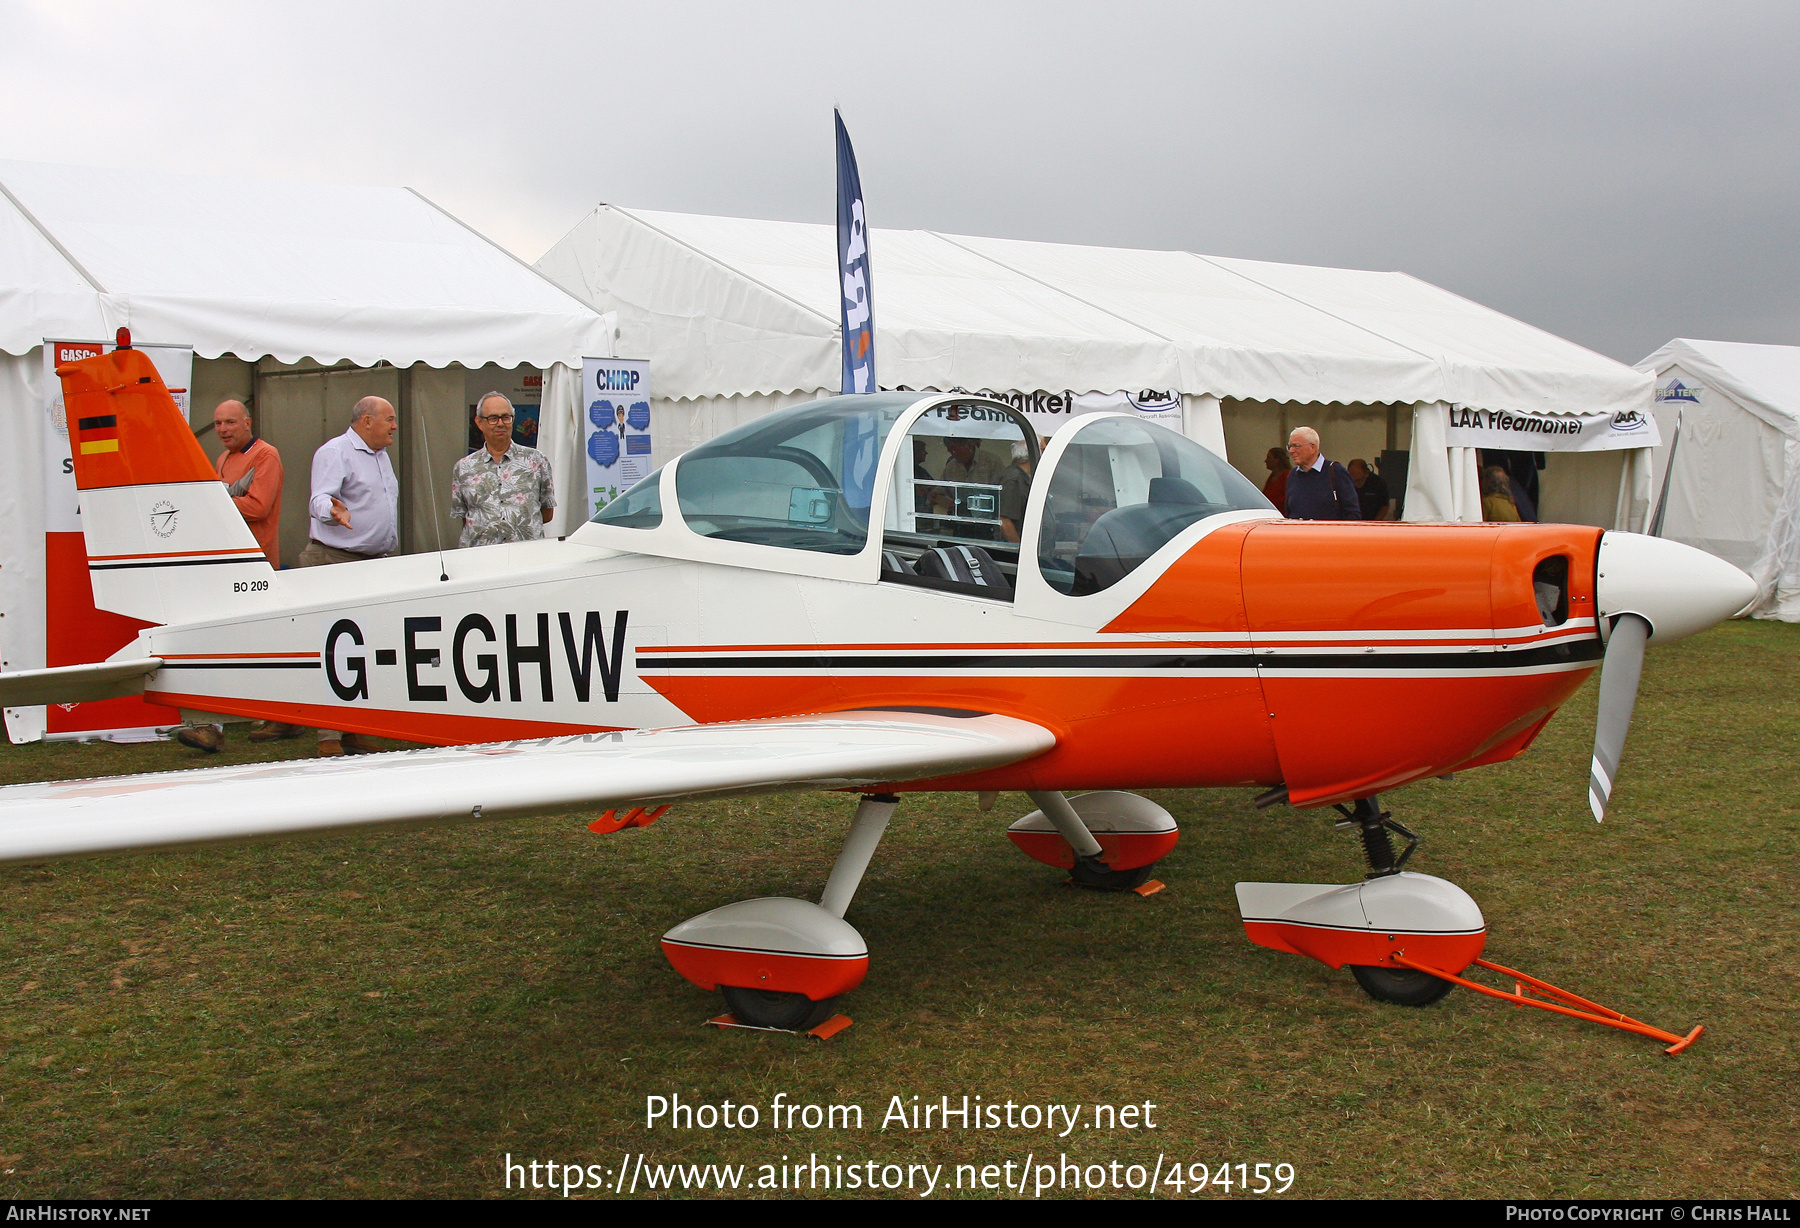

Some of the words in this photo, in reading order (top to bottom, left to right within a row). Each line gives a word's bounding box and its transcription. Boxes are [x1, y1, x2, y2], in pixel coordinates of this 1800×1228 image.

[597, 369, 639, 390] CHIRP
[1655, 388, 1675, 397] ALA
[1449, 404, 1483, 429] LAA
[233, 582, 248, 593] BO
[250, 580, 269, 592] 209
[325, 610, 629, 703] G-EGHW
